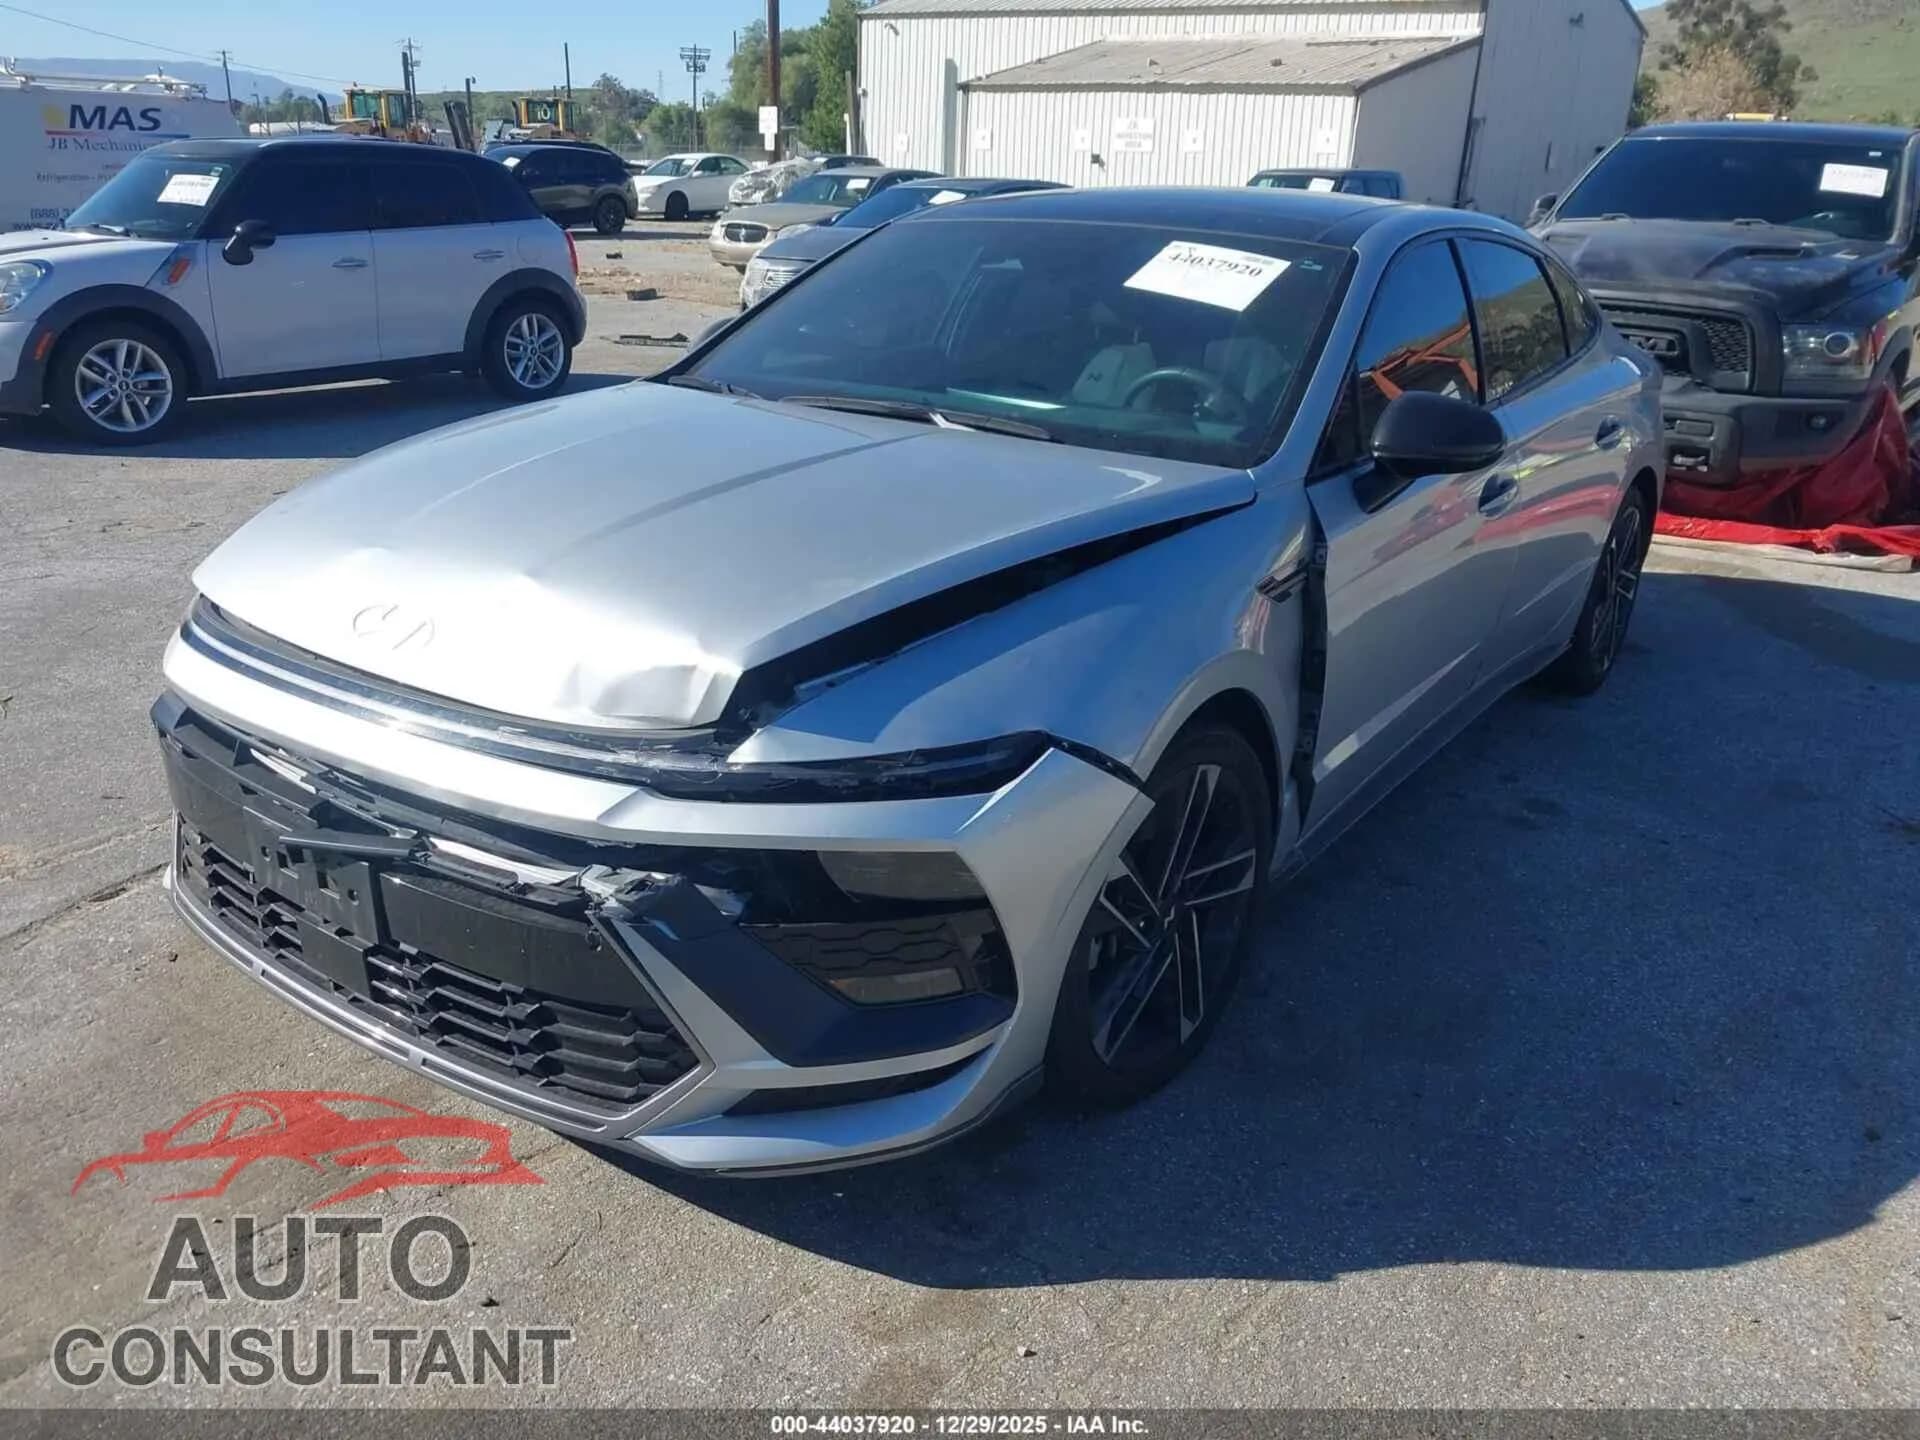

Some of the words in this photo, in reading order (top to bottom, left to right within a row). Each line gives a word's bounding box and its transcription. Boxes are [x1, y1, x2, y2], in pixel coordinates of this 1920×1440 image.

[69, 104, 162, 131] MAS
[48, 137, 68, 150] JB
[73, 137, 162, 152] Mechanic
[1168, 252, 1263, 277] 44037920
